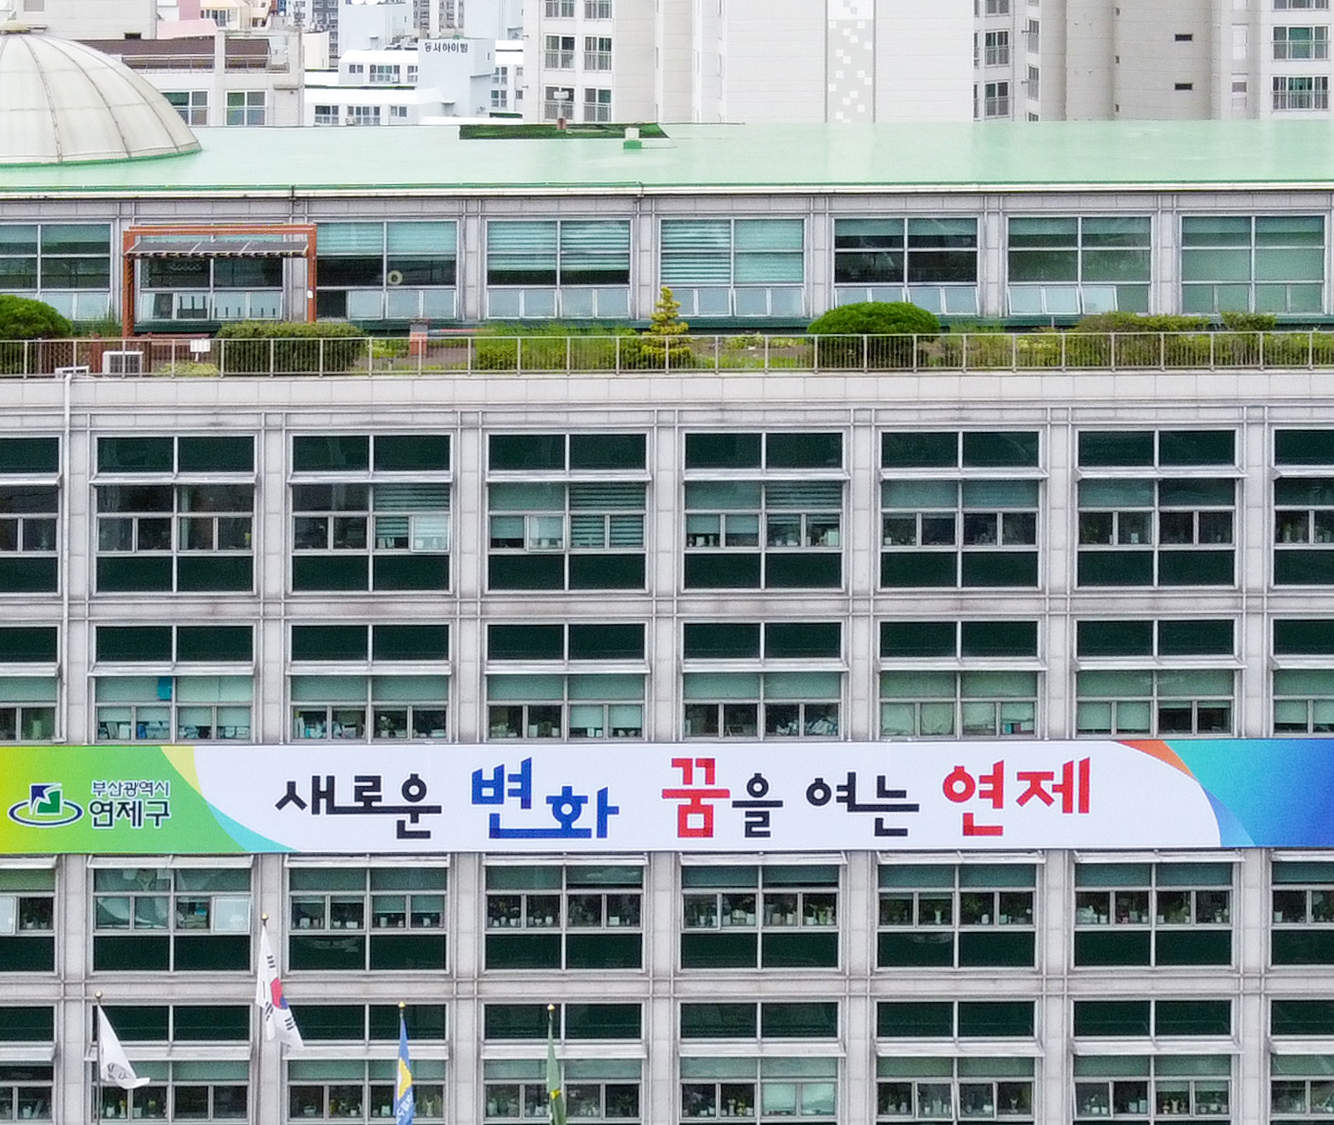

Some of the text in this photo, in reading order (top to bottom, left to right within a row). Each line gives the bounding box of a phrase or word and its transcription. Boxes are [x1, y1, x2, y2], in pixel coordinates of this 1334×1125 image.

[92, 781, 170, 797] 부산광역시
[275, 756, 1091, 839] 새로운 변화 꿈을 여는 연제
[89, 800, 171, 828] 연제구
